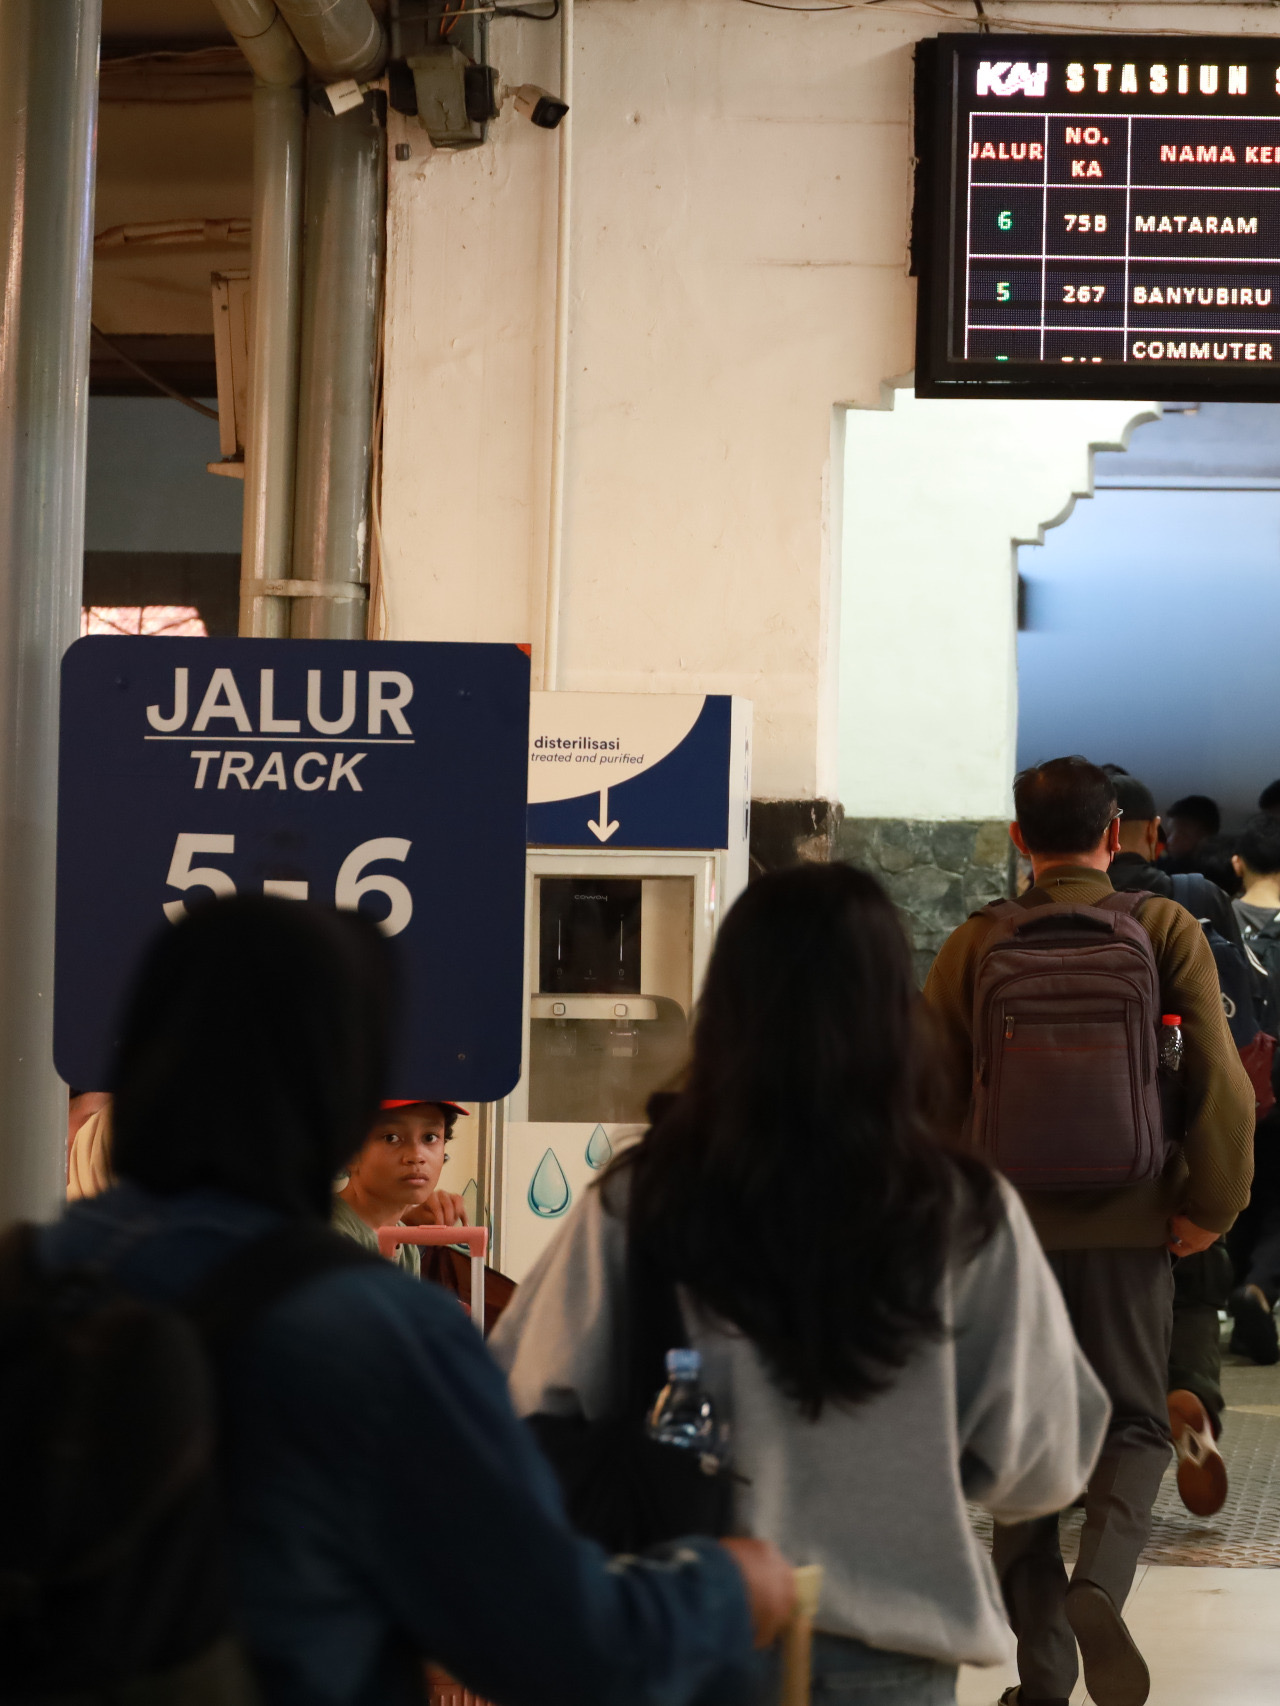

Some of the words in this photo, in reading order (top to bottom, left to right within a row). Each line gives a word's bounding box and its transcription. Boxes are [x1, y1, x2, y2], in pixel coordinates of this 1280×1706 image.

[976, 61, 1049, 98] KAI
[1065, 62, 1248, 96] STASIUN
[1065, 126, 1110, 146] NO.
[971, 142, 1043, 160] JALUR
[1160, 144, 1237, 164] NAMA
[1071, 159, 1103, 178] KA
[997, 210, 1013, 231] 6
[1063, 214, 1108, 233] 75B
[1135, 215, 1258, 235] MATARAM
[996, 281, 1011, 302] 5
[1062, 285, 1106, 304] 267
[1133, 286, 1271, 307] BANYUBIRU
[1132, 341, 1273, 361] COMMUTER
[146, 667, 414, 735] JALUR
[534, 736, 620, 751] disterilisasi
[531, 752, 573, 763] treated
[575, 753, 598, 764] and
[599, 754, 645, 766] purified
[190, 750, 367, 792] TRACK
